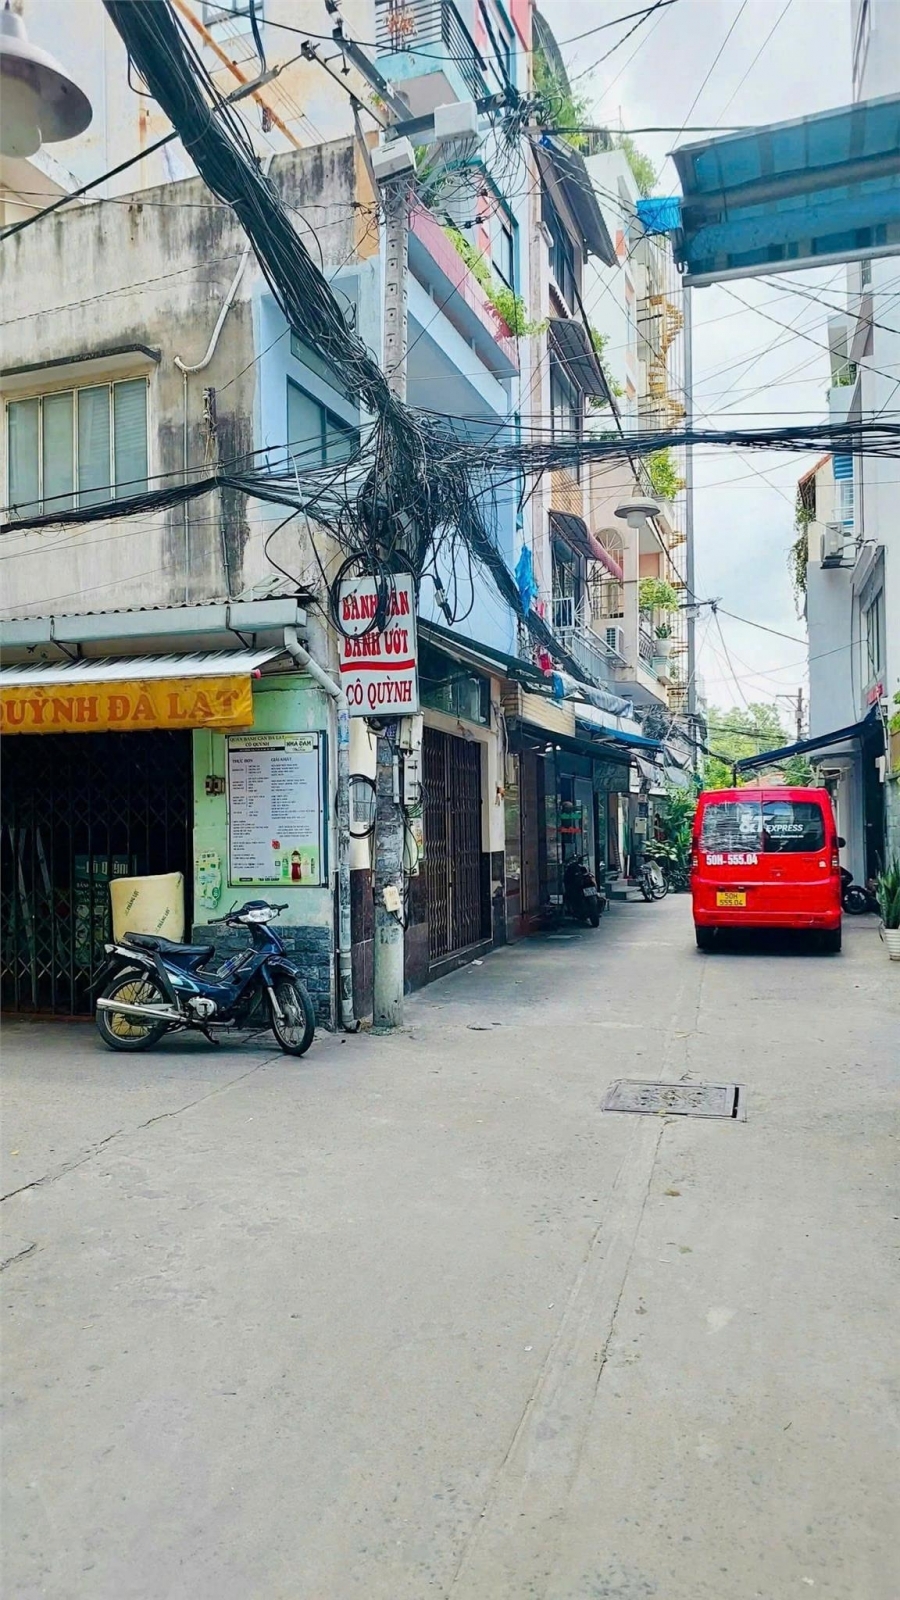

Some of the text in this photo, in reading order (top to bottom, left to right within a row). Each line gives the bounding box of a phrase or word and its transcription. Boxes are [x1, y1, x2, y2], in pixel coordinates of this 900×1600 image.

[384, 623, 408, 655] ƯỚT
[0, 691, 99, 730] UỲNH
[107, 687, 160, 722] ĐÀ
[346, 675, 413, 710] CÔ QUỲNH
[767, 824, 804, 832] EXPRESS
